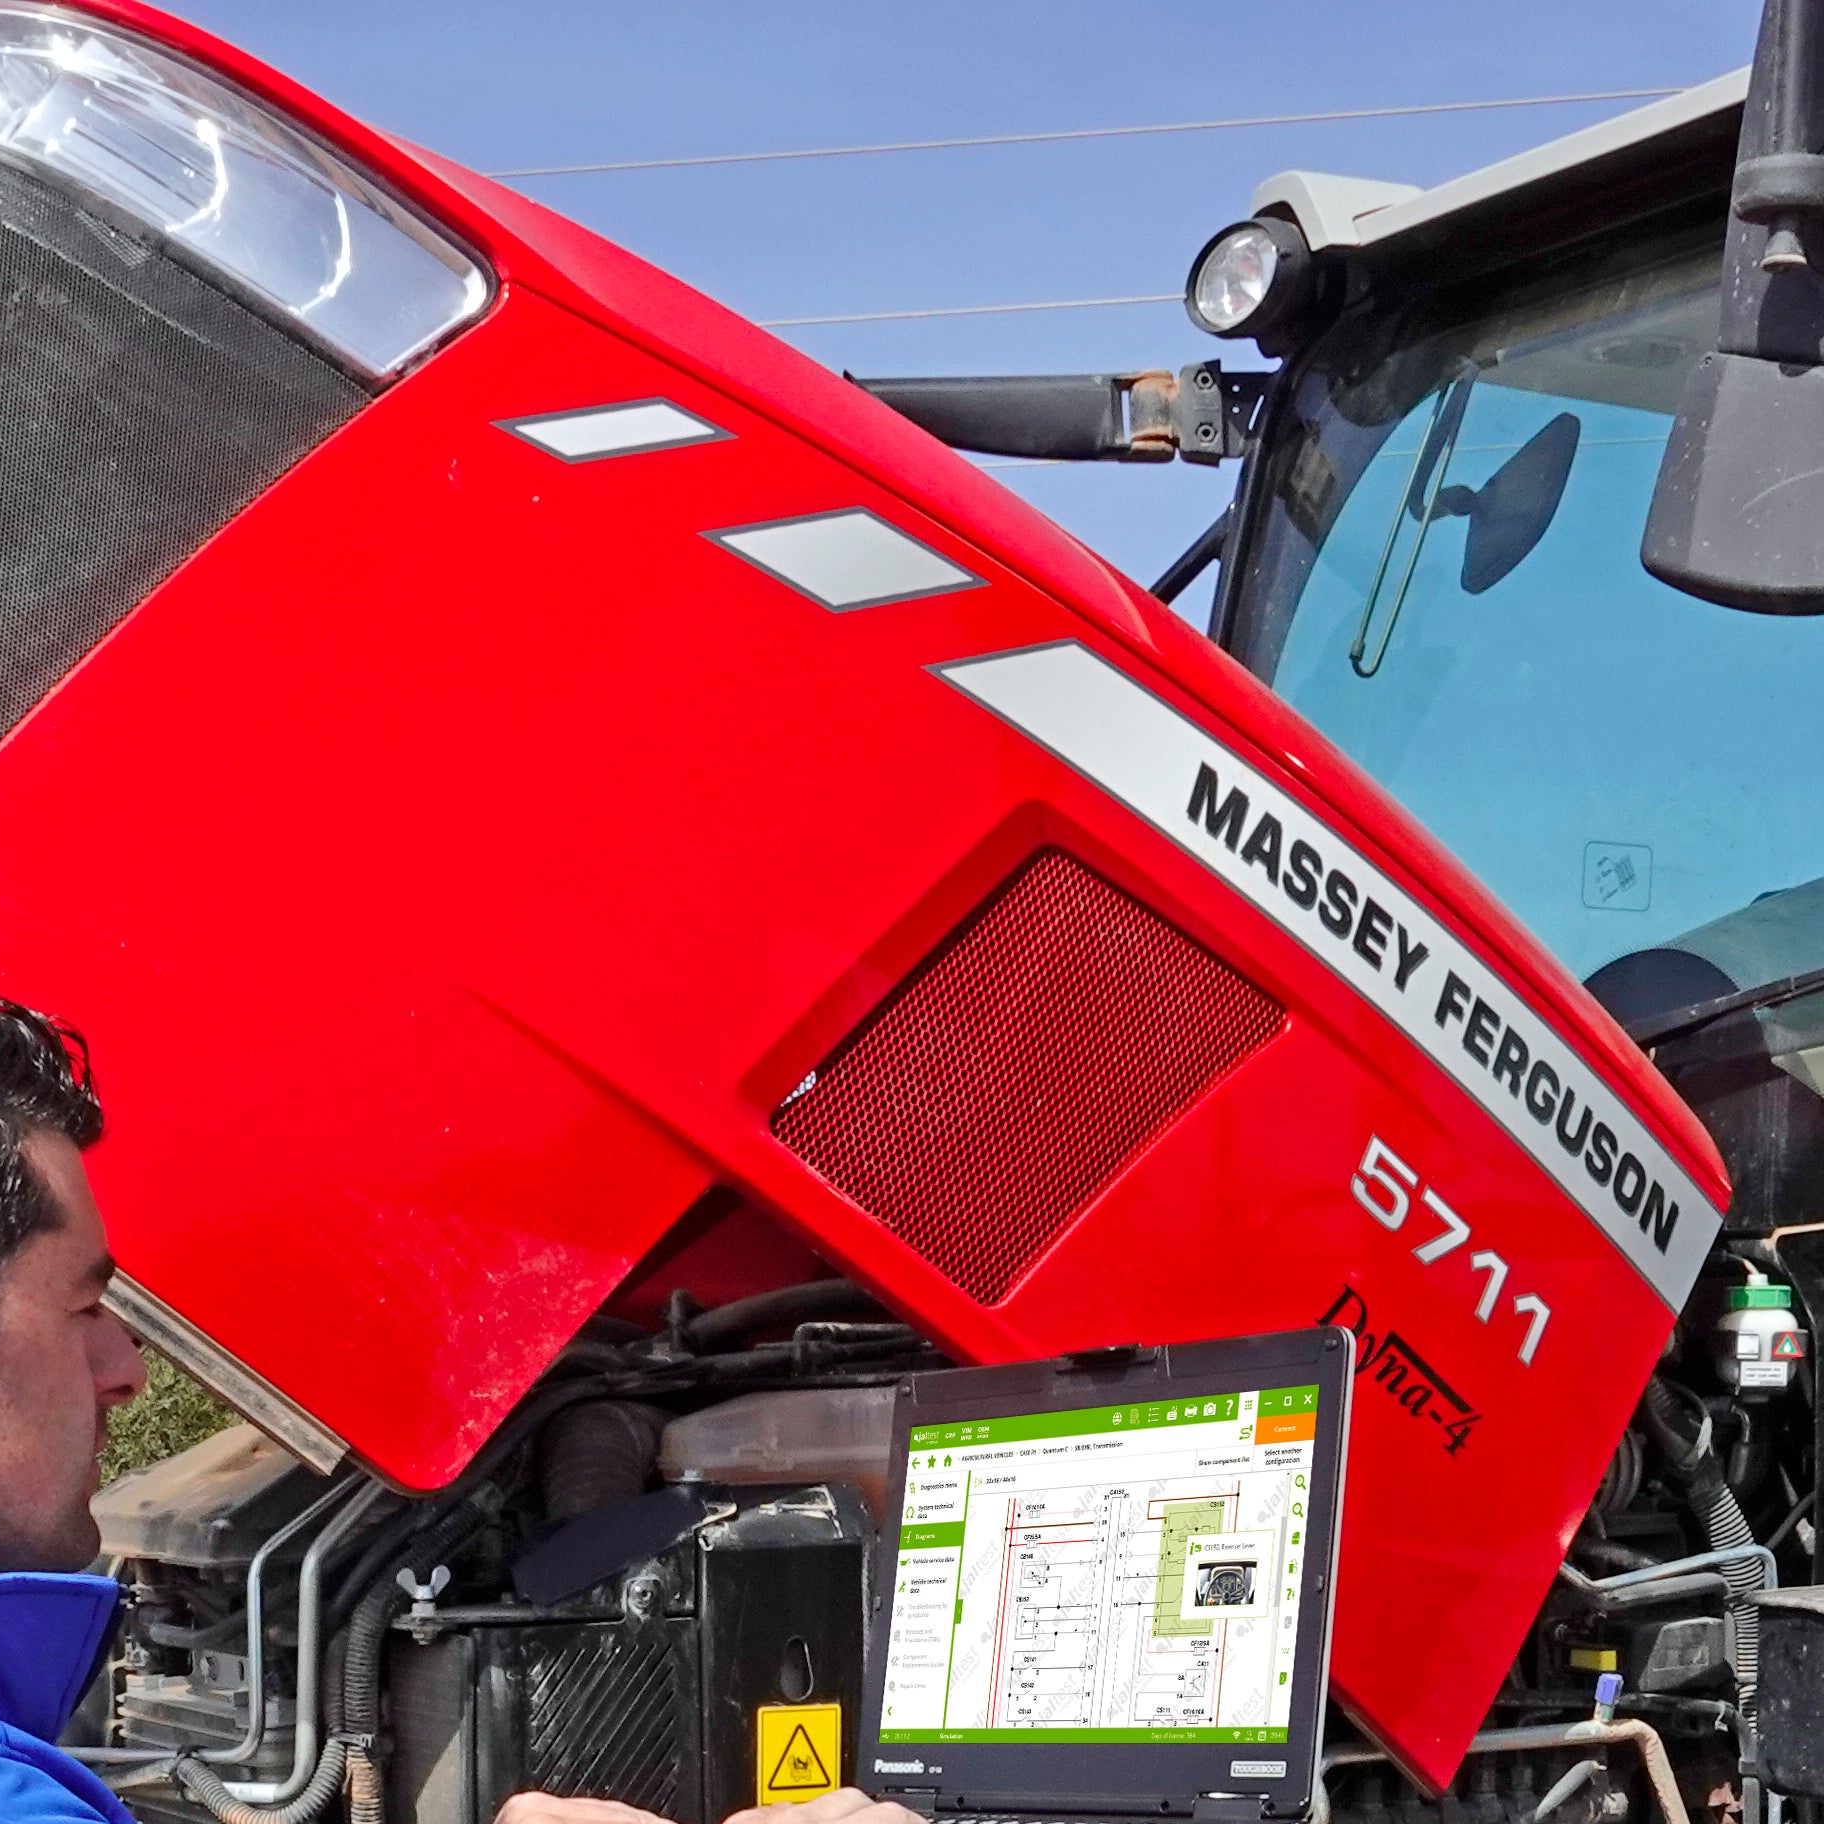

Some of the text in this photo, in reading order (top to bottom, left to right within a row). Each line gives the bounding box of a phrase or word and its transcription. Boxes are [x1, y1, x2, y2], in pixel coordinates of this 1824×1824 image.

[1185, 761, 1679, 1258] MASSEY FERGUSON
[1350, 1133, 1552, 1368] 5711
[1315, 1284, 1483, 1457] Dyna-4
[1093, 1441, 1123, 1449] Transmission
[1265, 1457, 1300, 1466] configuration
[921, 1483, 944, 1491] Diagnostics
[934, 1502, 954, 1510] technical
[1151, 1732, 1162, 1740] Days
[874, 1759, 924, 1774] Panasonic
